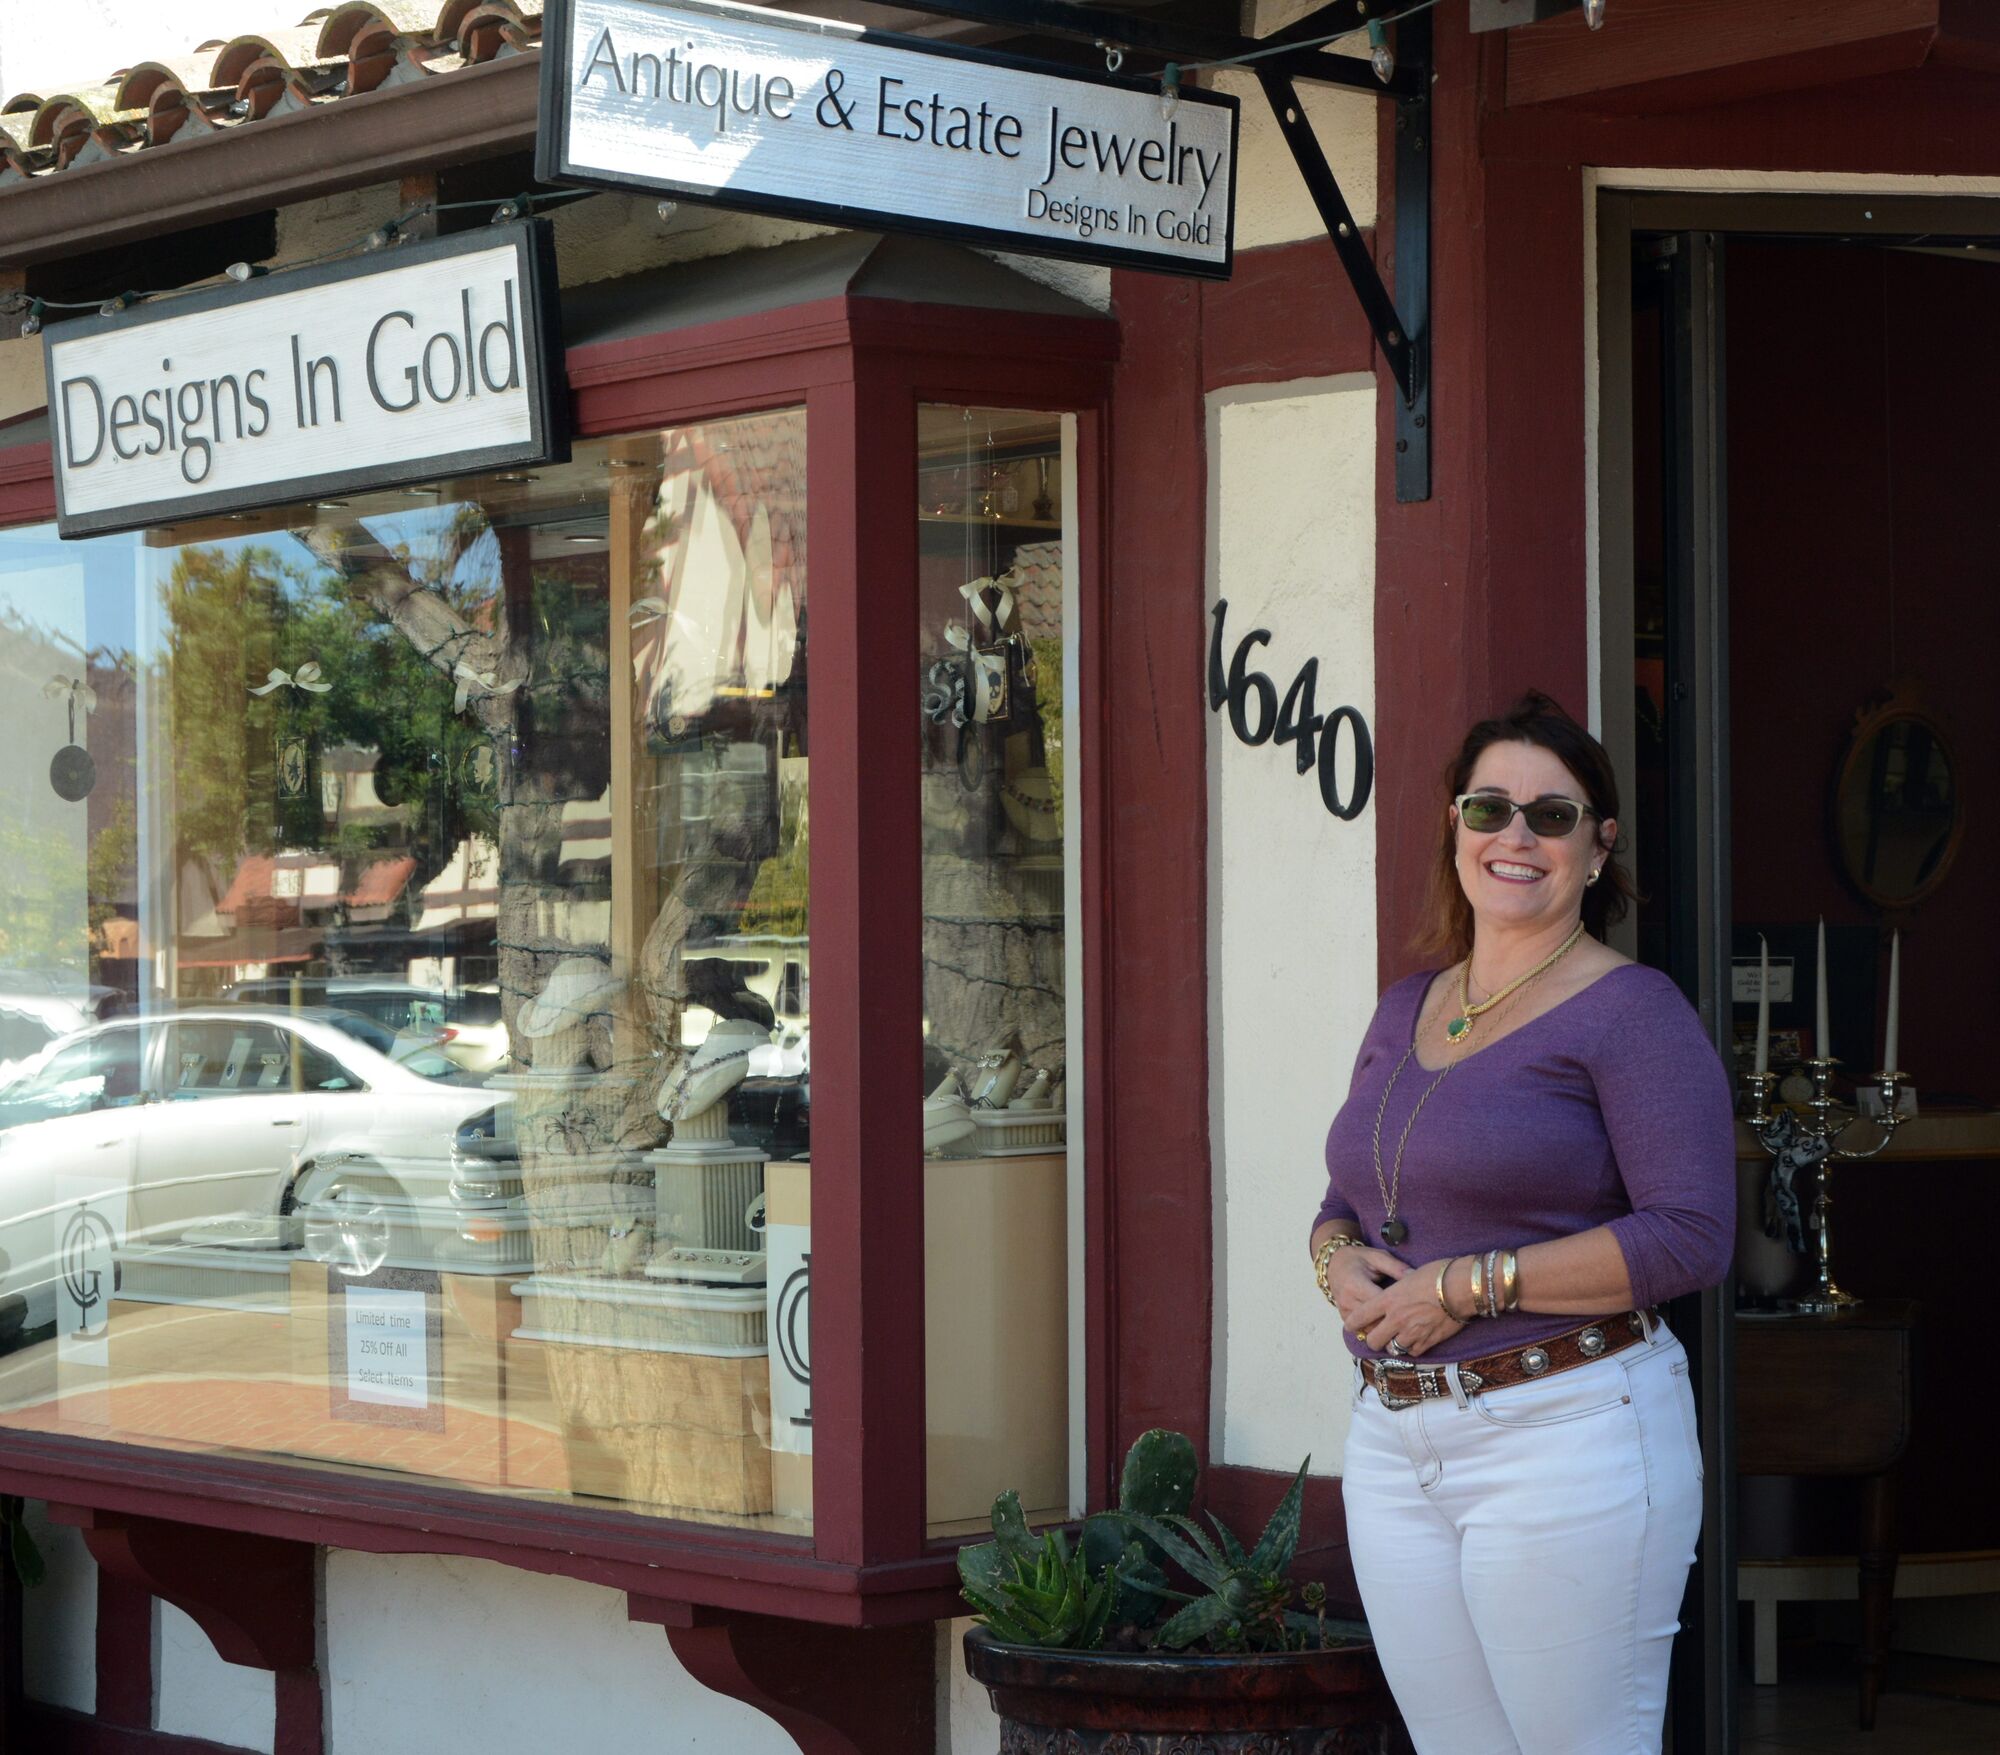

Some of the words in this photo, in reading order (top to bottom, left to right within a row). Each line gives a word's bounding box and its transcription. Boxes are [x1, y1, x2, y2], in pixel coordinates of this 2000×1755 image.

[582, 26, 794, 132] Antique
[815, 69, 856, 131] &
[877, 76, 1023, 158] Estate
[1041, 106, 1222, 209] Jewelry
[1028, 188, 1119, 237] Designs
[1128, 204, 1147, 236] In
[1156, 209, 1212, 245] Gold
[61, 357, 271, 484] Designs
[291, 334, 344, 429] In
[366, 279, 522, 413] Gold
[1208, 598, 1374, 821] 1640
[355, 1311, 386, 1328] Limited
[390, 1312, 411, 1328] time
[358, 1368, 384, 1384] Select
[360, 1340, 378, 1355] 25%
[380, 1342, 394, 1356] Off
[395, 1344, 408, 1357] All
